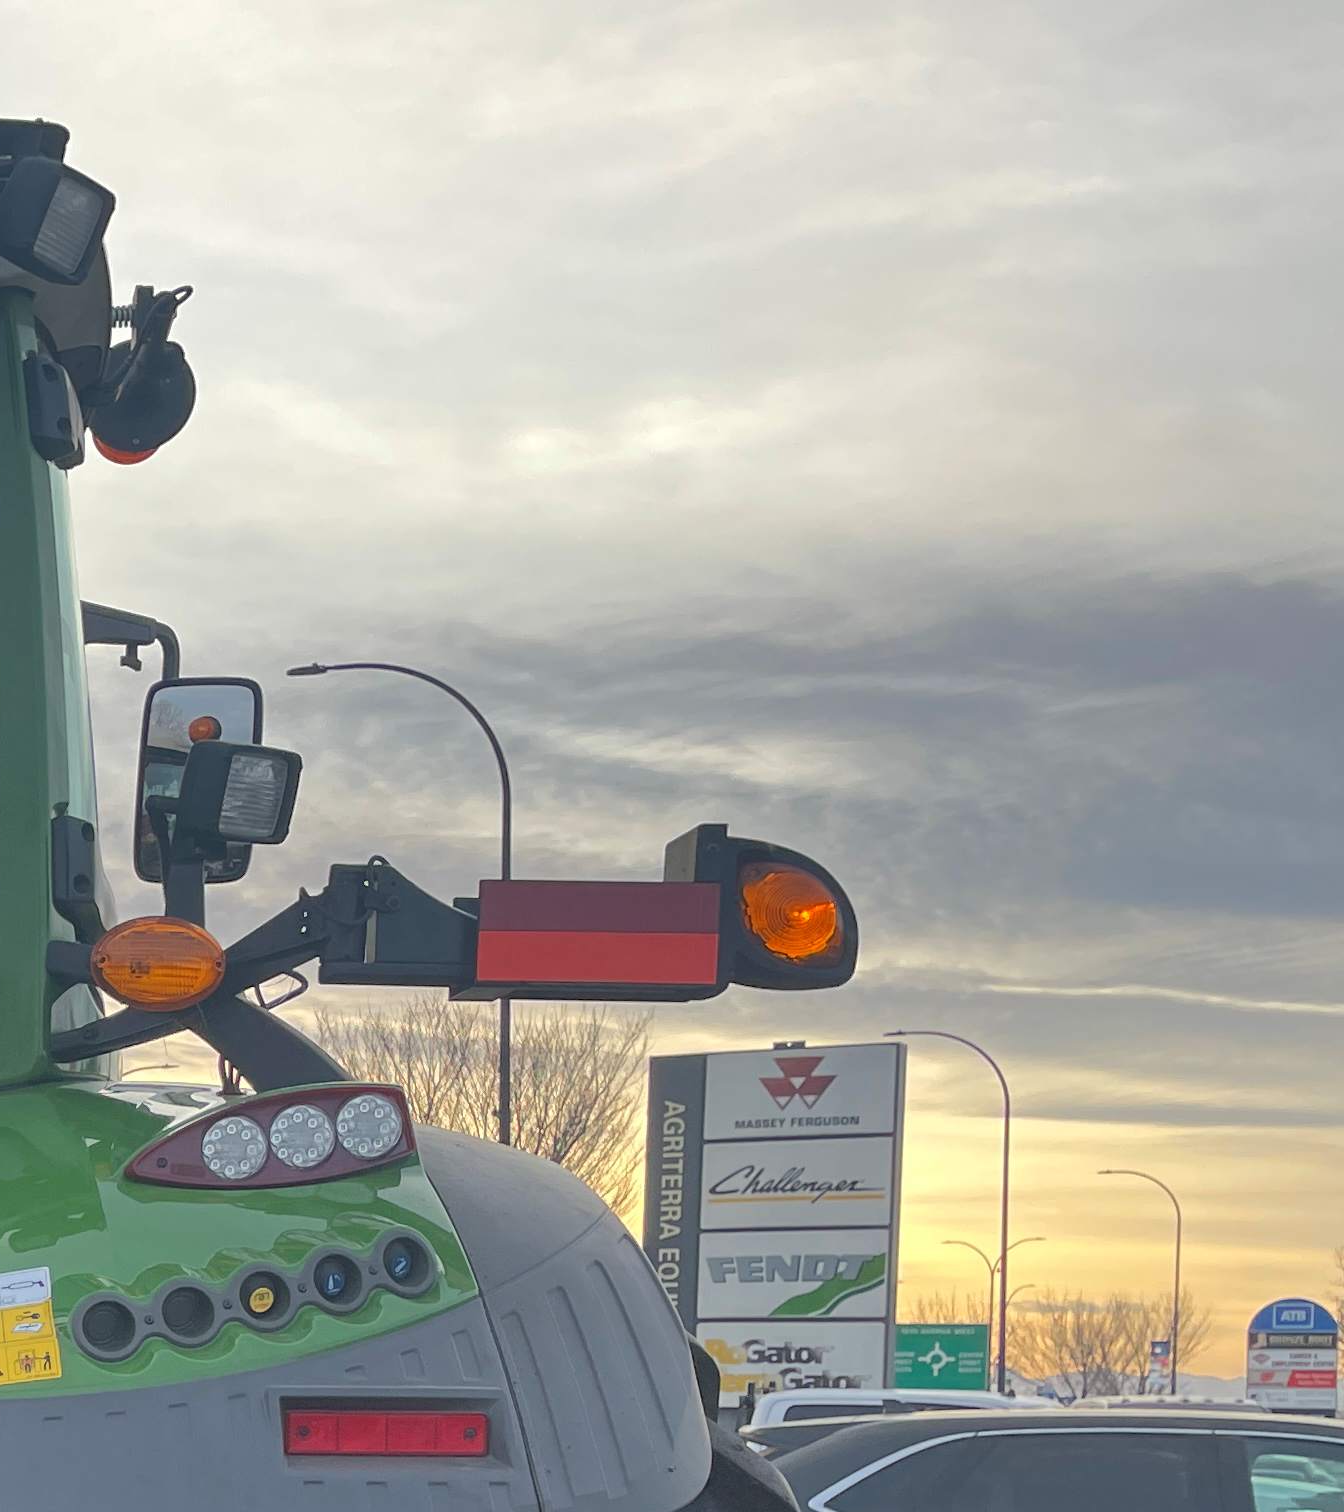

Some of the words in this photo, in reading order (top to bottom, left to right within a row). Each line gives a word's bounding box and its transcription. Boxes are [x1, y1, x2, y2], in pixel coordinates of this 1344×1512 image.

[734, 1117, 786, 1129] MASSEY
[790, 1115, 861, 1128] FERGUSON
[659, 1100, 686, 1240] AGRITERRA
[708, 1165, 885, 1204] Challenger
[657, 1247, 681, 1307] EQU
[706, 1254, 875, 1284] FENDT
[1280, 1310, 1307, 1322] ATB
